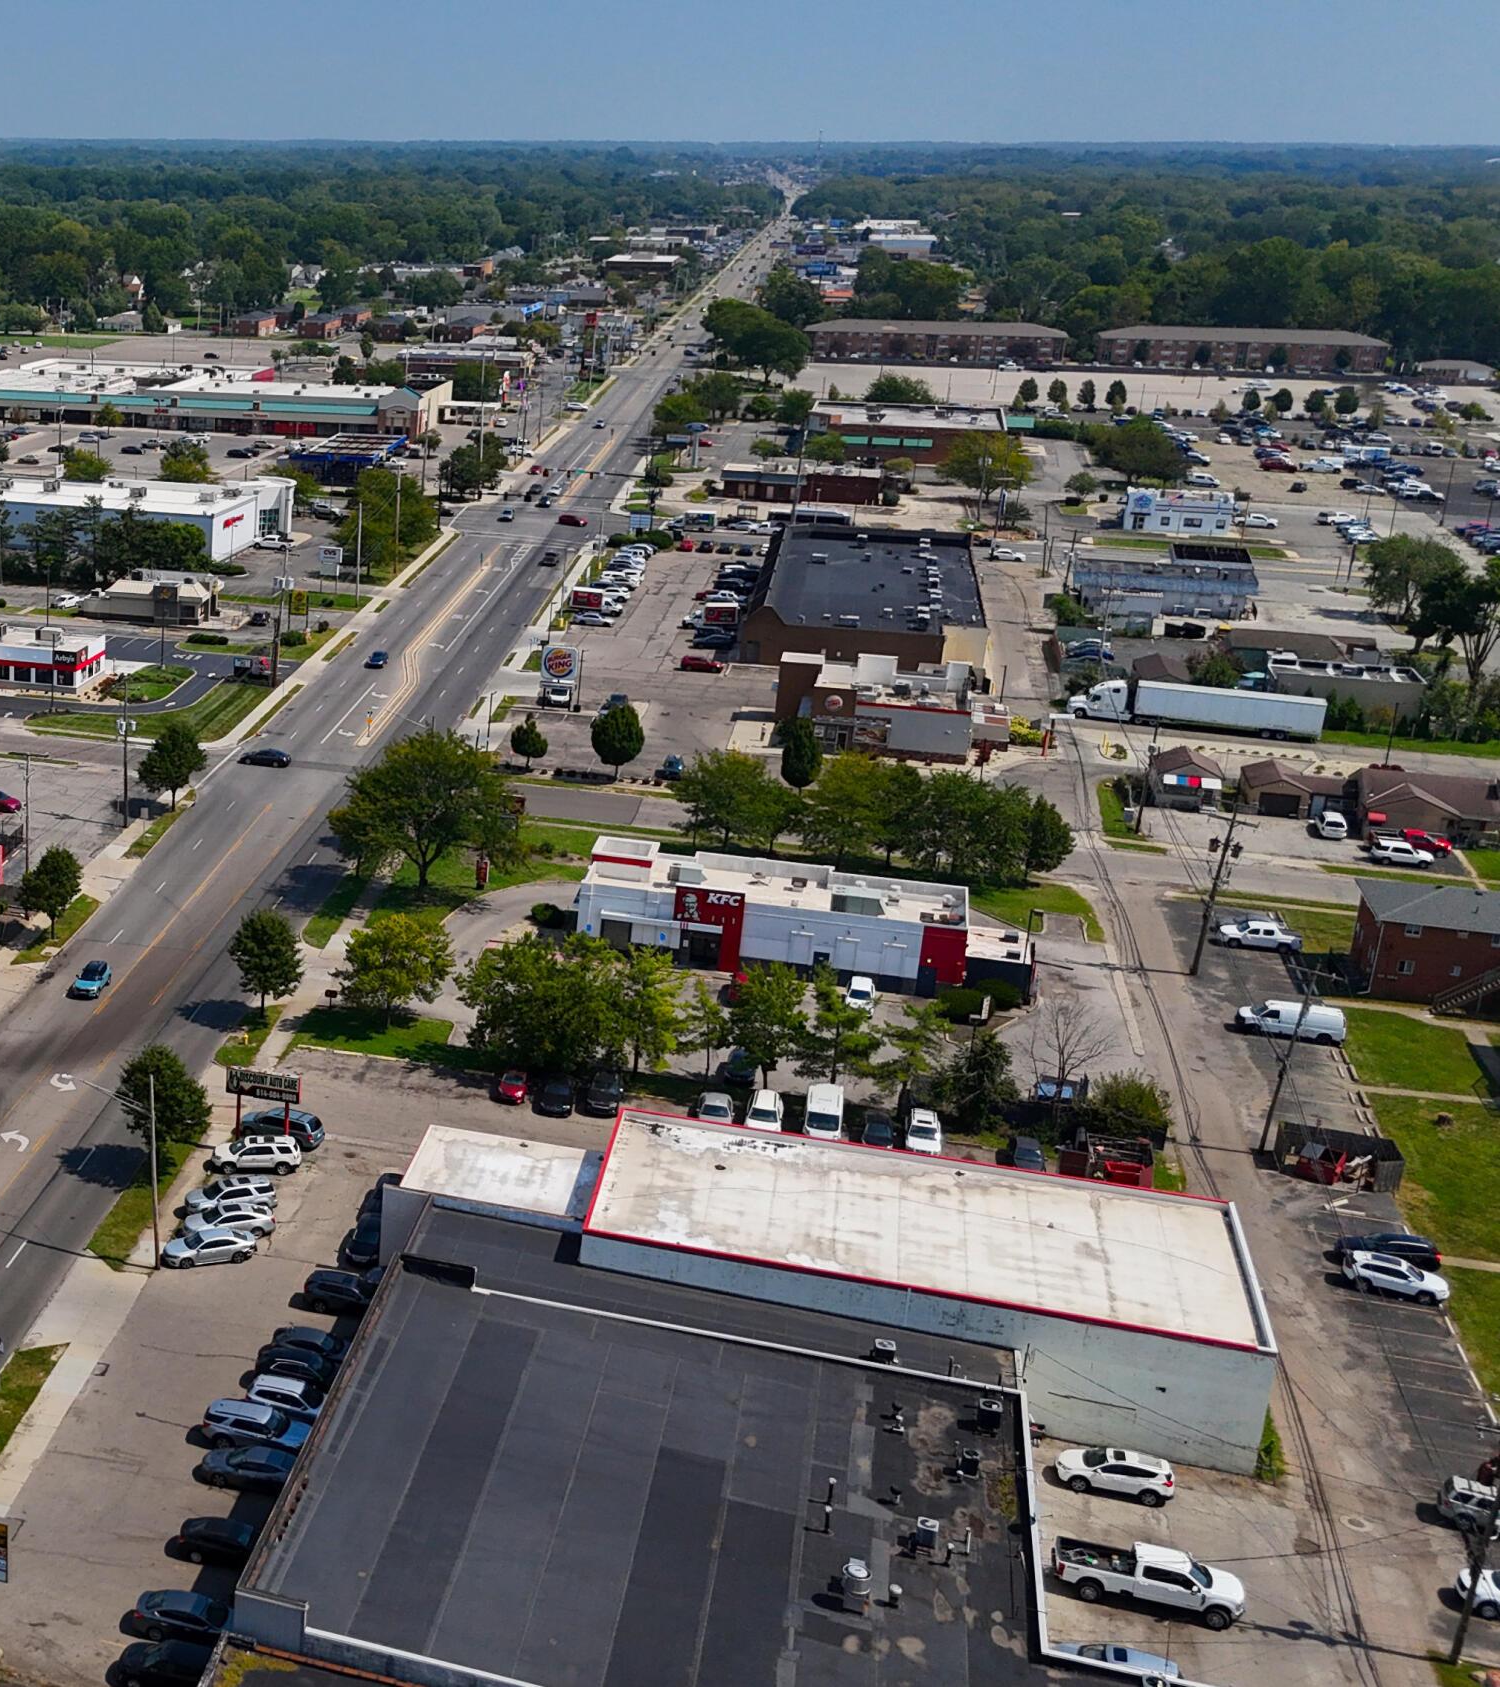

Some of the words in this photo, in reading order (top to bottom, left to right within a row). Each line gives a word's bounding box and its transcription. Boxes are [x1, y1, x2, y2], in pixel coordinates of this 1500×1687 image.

[54, 653, 75, 663] Arby's
[548, 660, 572, 671] KING
[707, 893, 741, 906] KFC
[240, 1071, 268, 1086] DISCOUNT
[269, 1076, 283, 1088] AUTO
[284, 1077, 298, 1091] CARE
